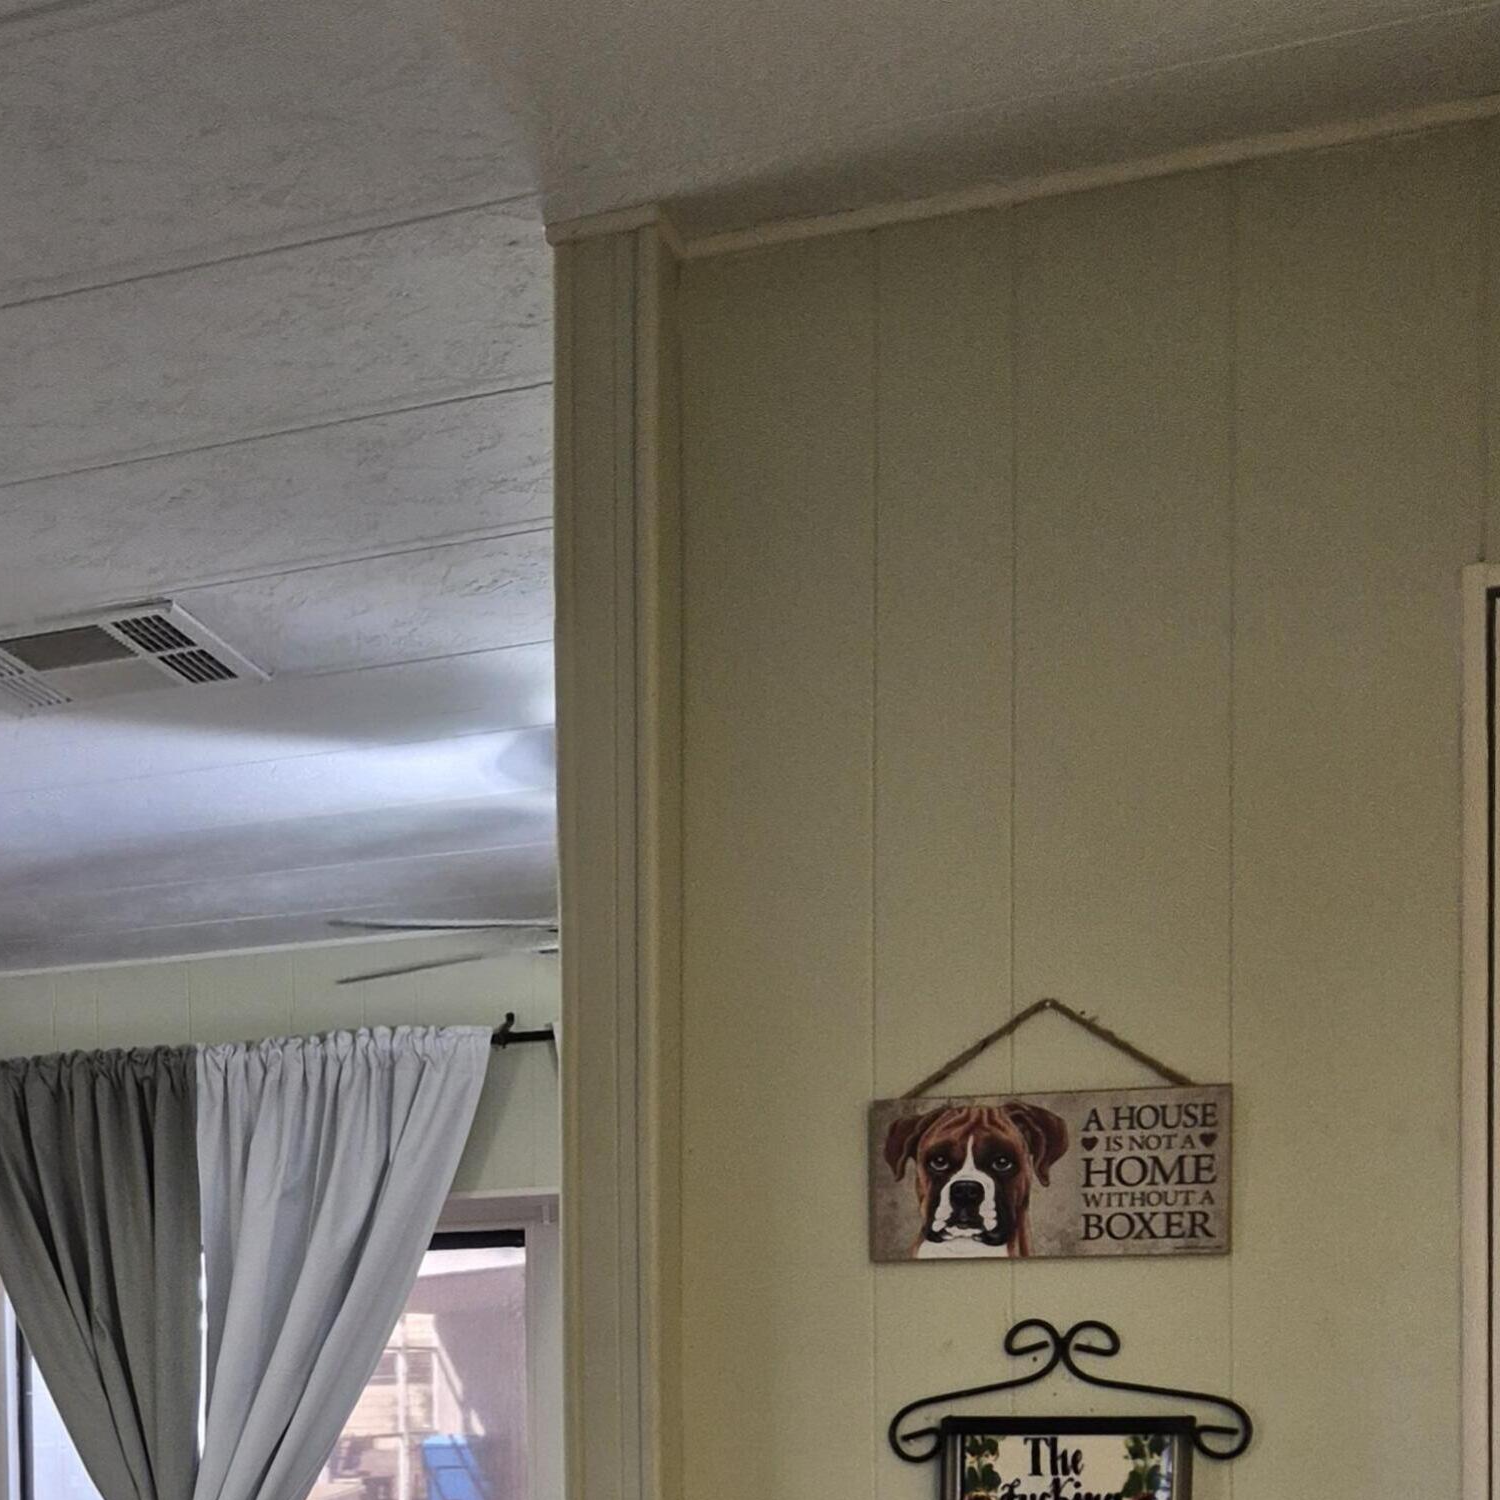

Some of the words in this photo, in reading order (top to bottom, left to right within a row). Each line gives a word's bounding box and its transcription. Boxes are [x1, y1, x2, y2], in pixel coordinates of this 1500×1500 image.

[1081, 1107, 1104, 1132] A
[1113, 1103, 1219, 1131] HOUSE
[1104, 1134, 1123, 1152] IS
[1128, 1133, 1178, 1151] NOT
[1181, 1133, 1197, 1150] A
[1081, 1153, 1217, 1188] HOME
[1082, 1190, 1195, 1208] WITHOUT
[1197, 1189, 1215, 1206] A
[1082, 1210, 1216, 1241] BOXER
[1024, 1436, 1085, 1477] The
